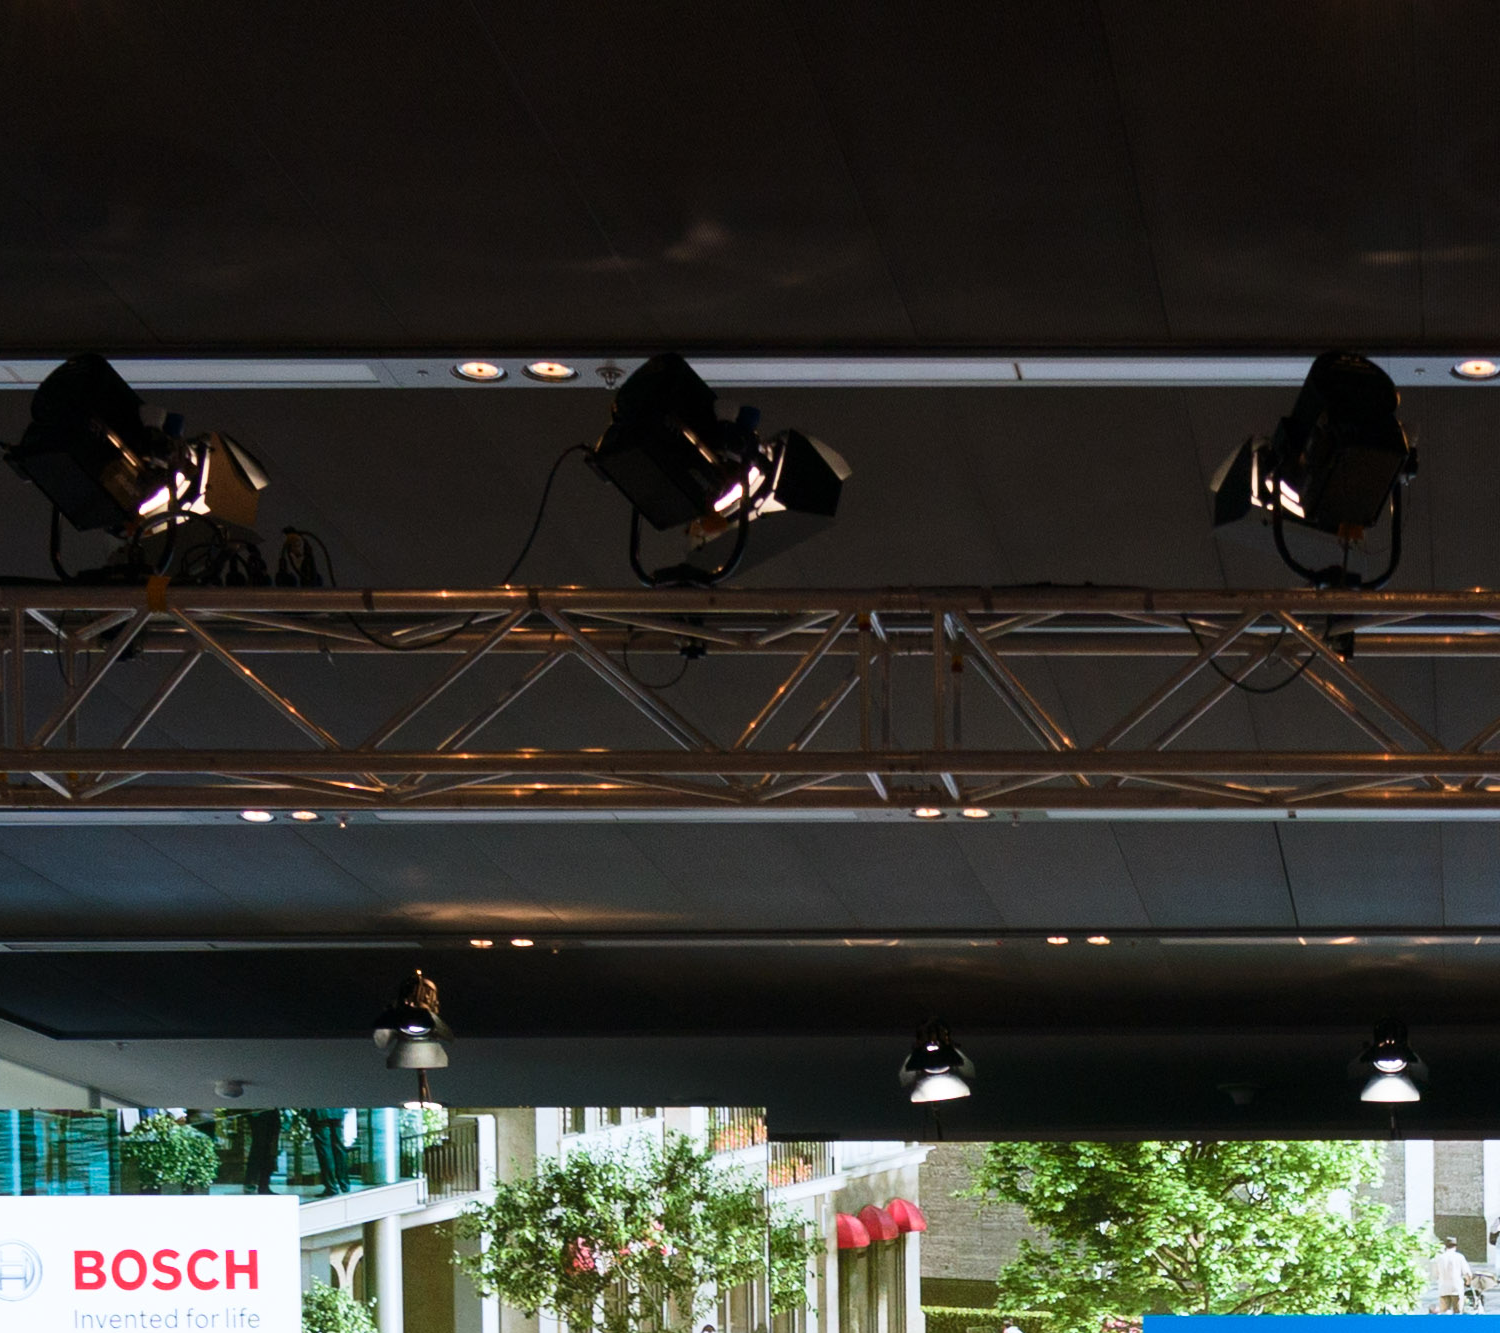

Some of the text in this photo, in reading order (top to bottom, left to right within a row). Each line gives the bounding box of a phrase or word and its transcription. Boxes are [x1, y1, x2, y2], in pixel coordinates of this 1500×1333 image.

[74, 1249, 259, 1291] BOSCH
[74, 1307, 260, 1330] Invented for life
